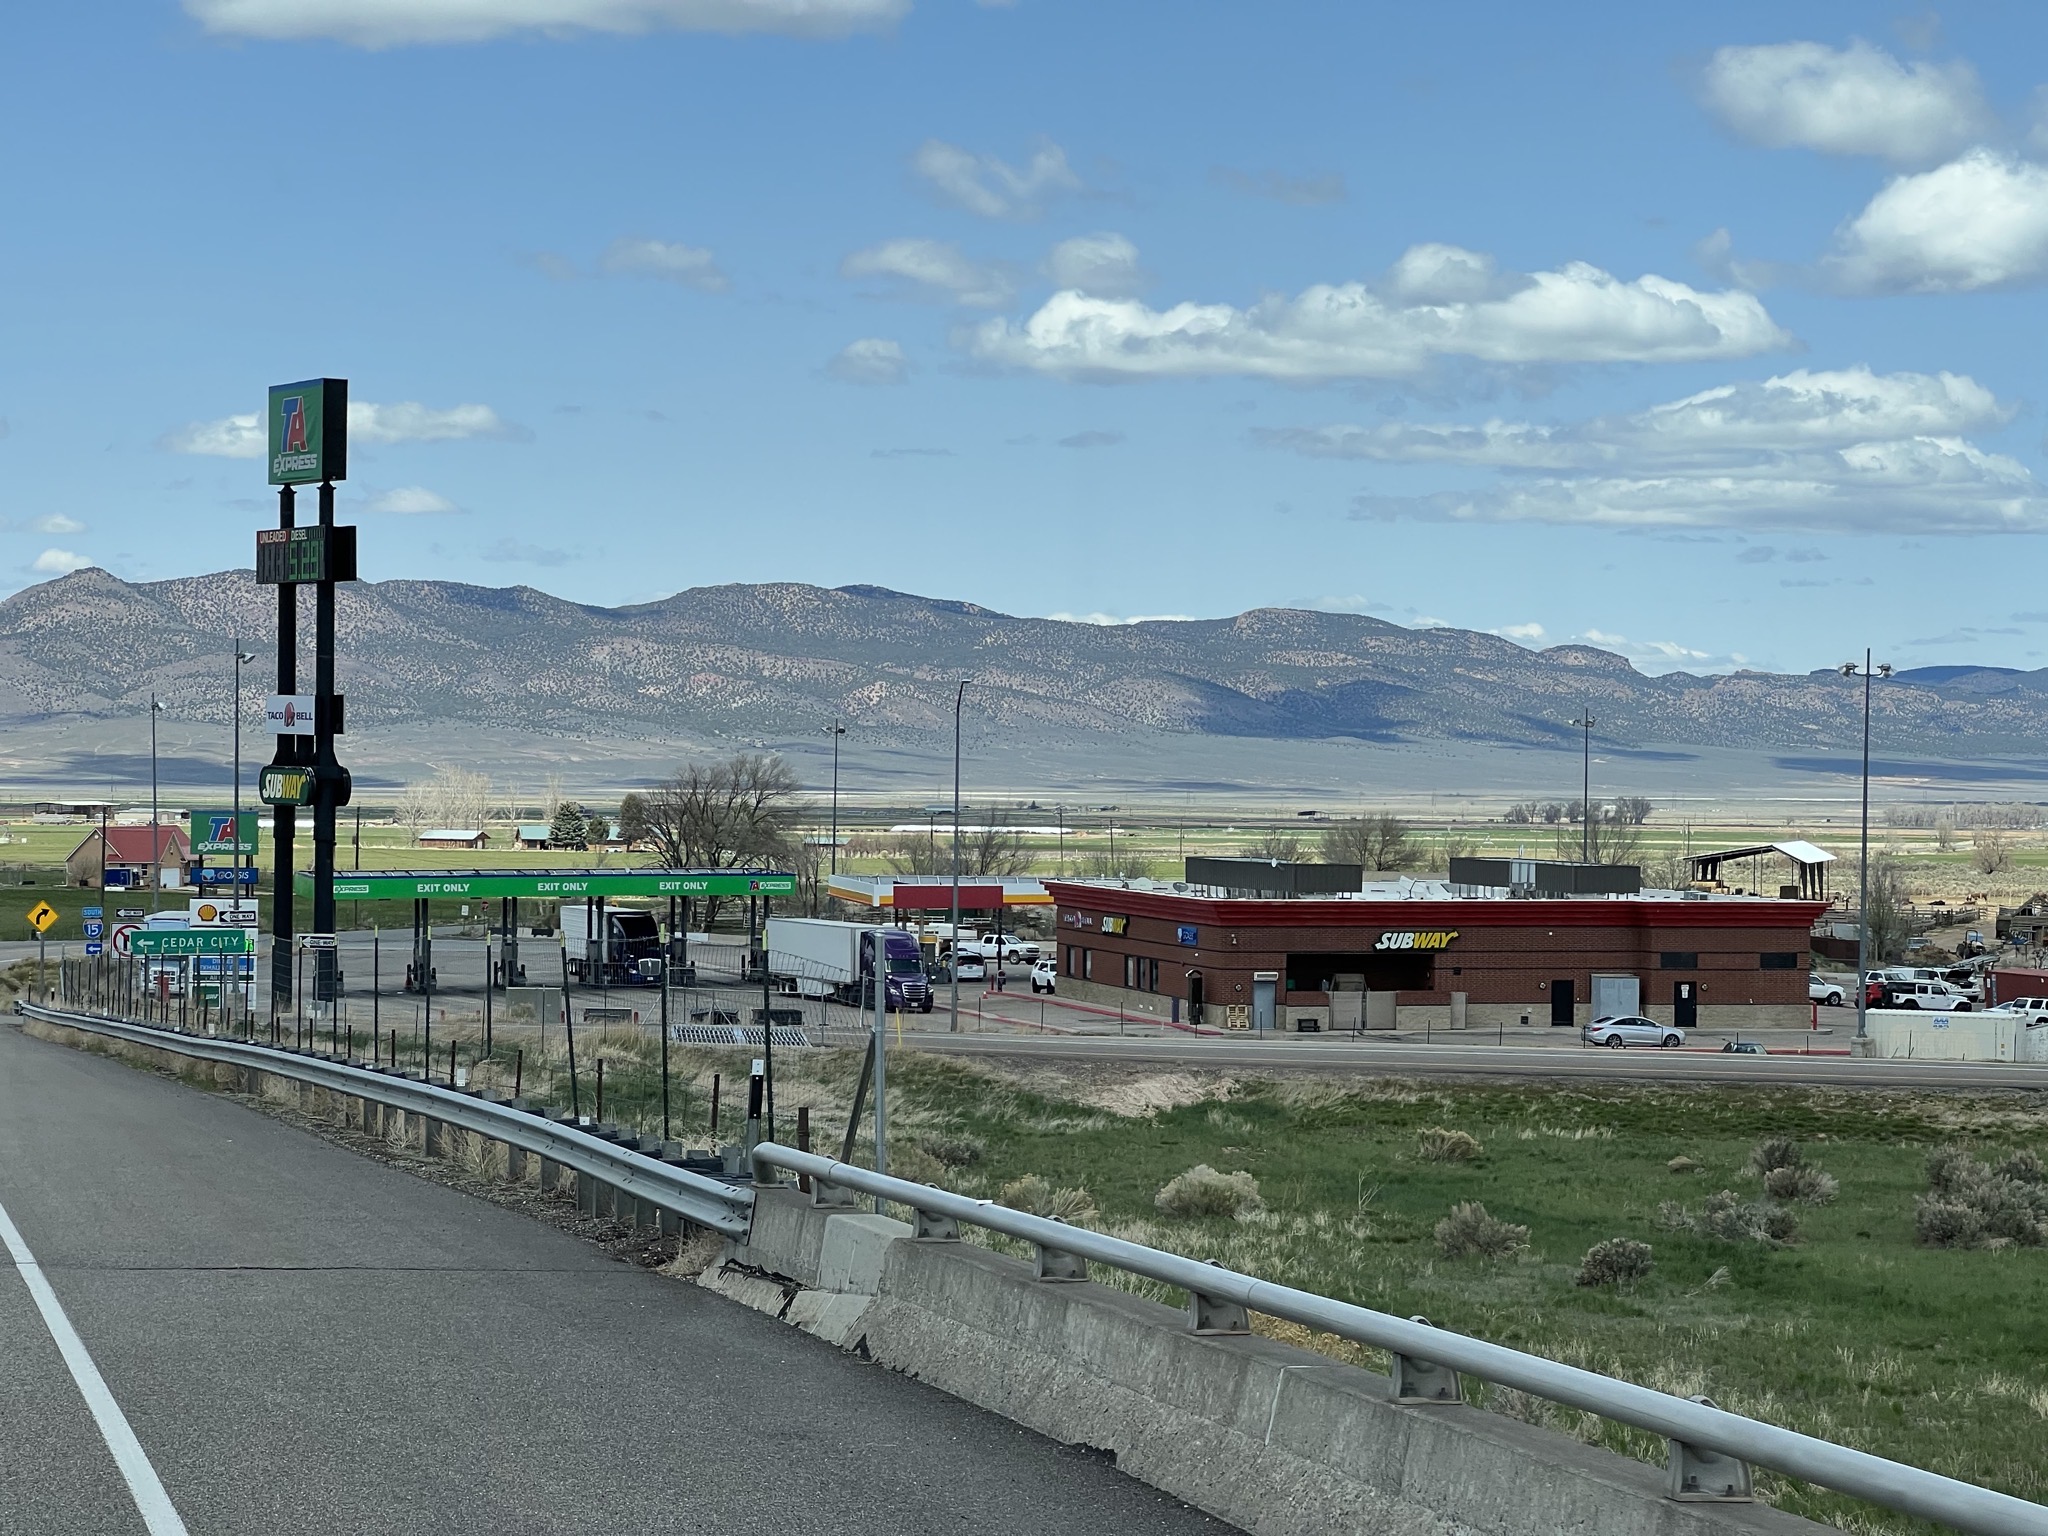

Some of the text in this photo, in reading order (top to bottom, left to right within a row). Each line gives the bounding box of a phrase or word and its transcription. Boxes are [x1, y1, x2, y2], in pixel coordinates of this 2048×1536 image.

[281, 396, 308, 454] TA
[260, 529, 308, 544] UNLEADED DIESEL
[267, 711, 313, 720] TACO BELL
[262, 773, 306, 799] SUBWAY
[209, 816, 241, 842] TA
[417, 883, 470, 893] EXIT ONLY
[537, 882, 588, 891] EXIT ONLY
[659, 881, 708, 890] EXIT ONLY
[87, 924, 99, 935] 15
[162, 937, 204, 948] CEDAR
[211, 936, 239, 947] CITY
[1375, 931, 1459, 950] SUBWAY
